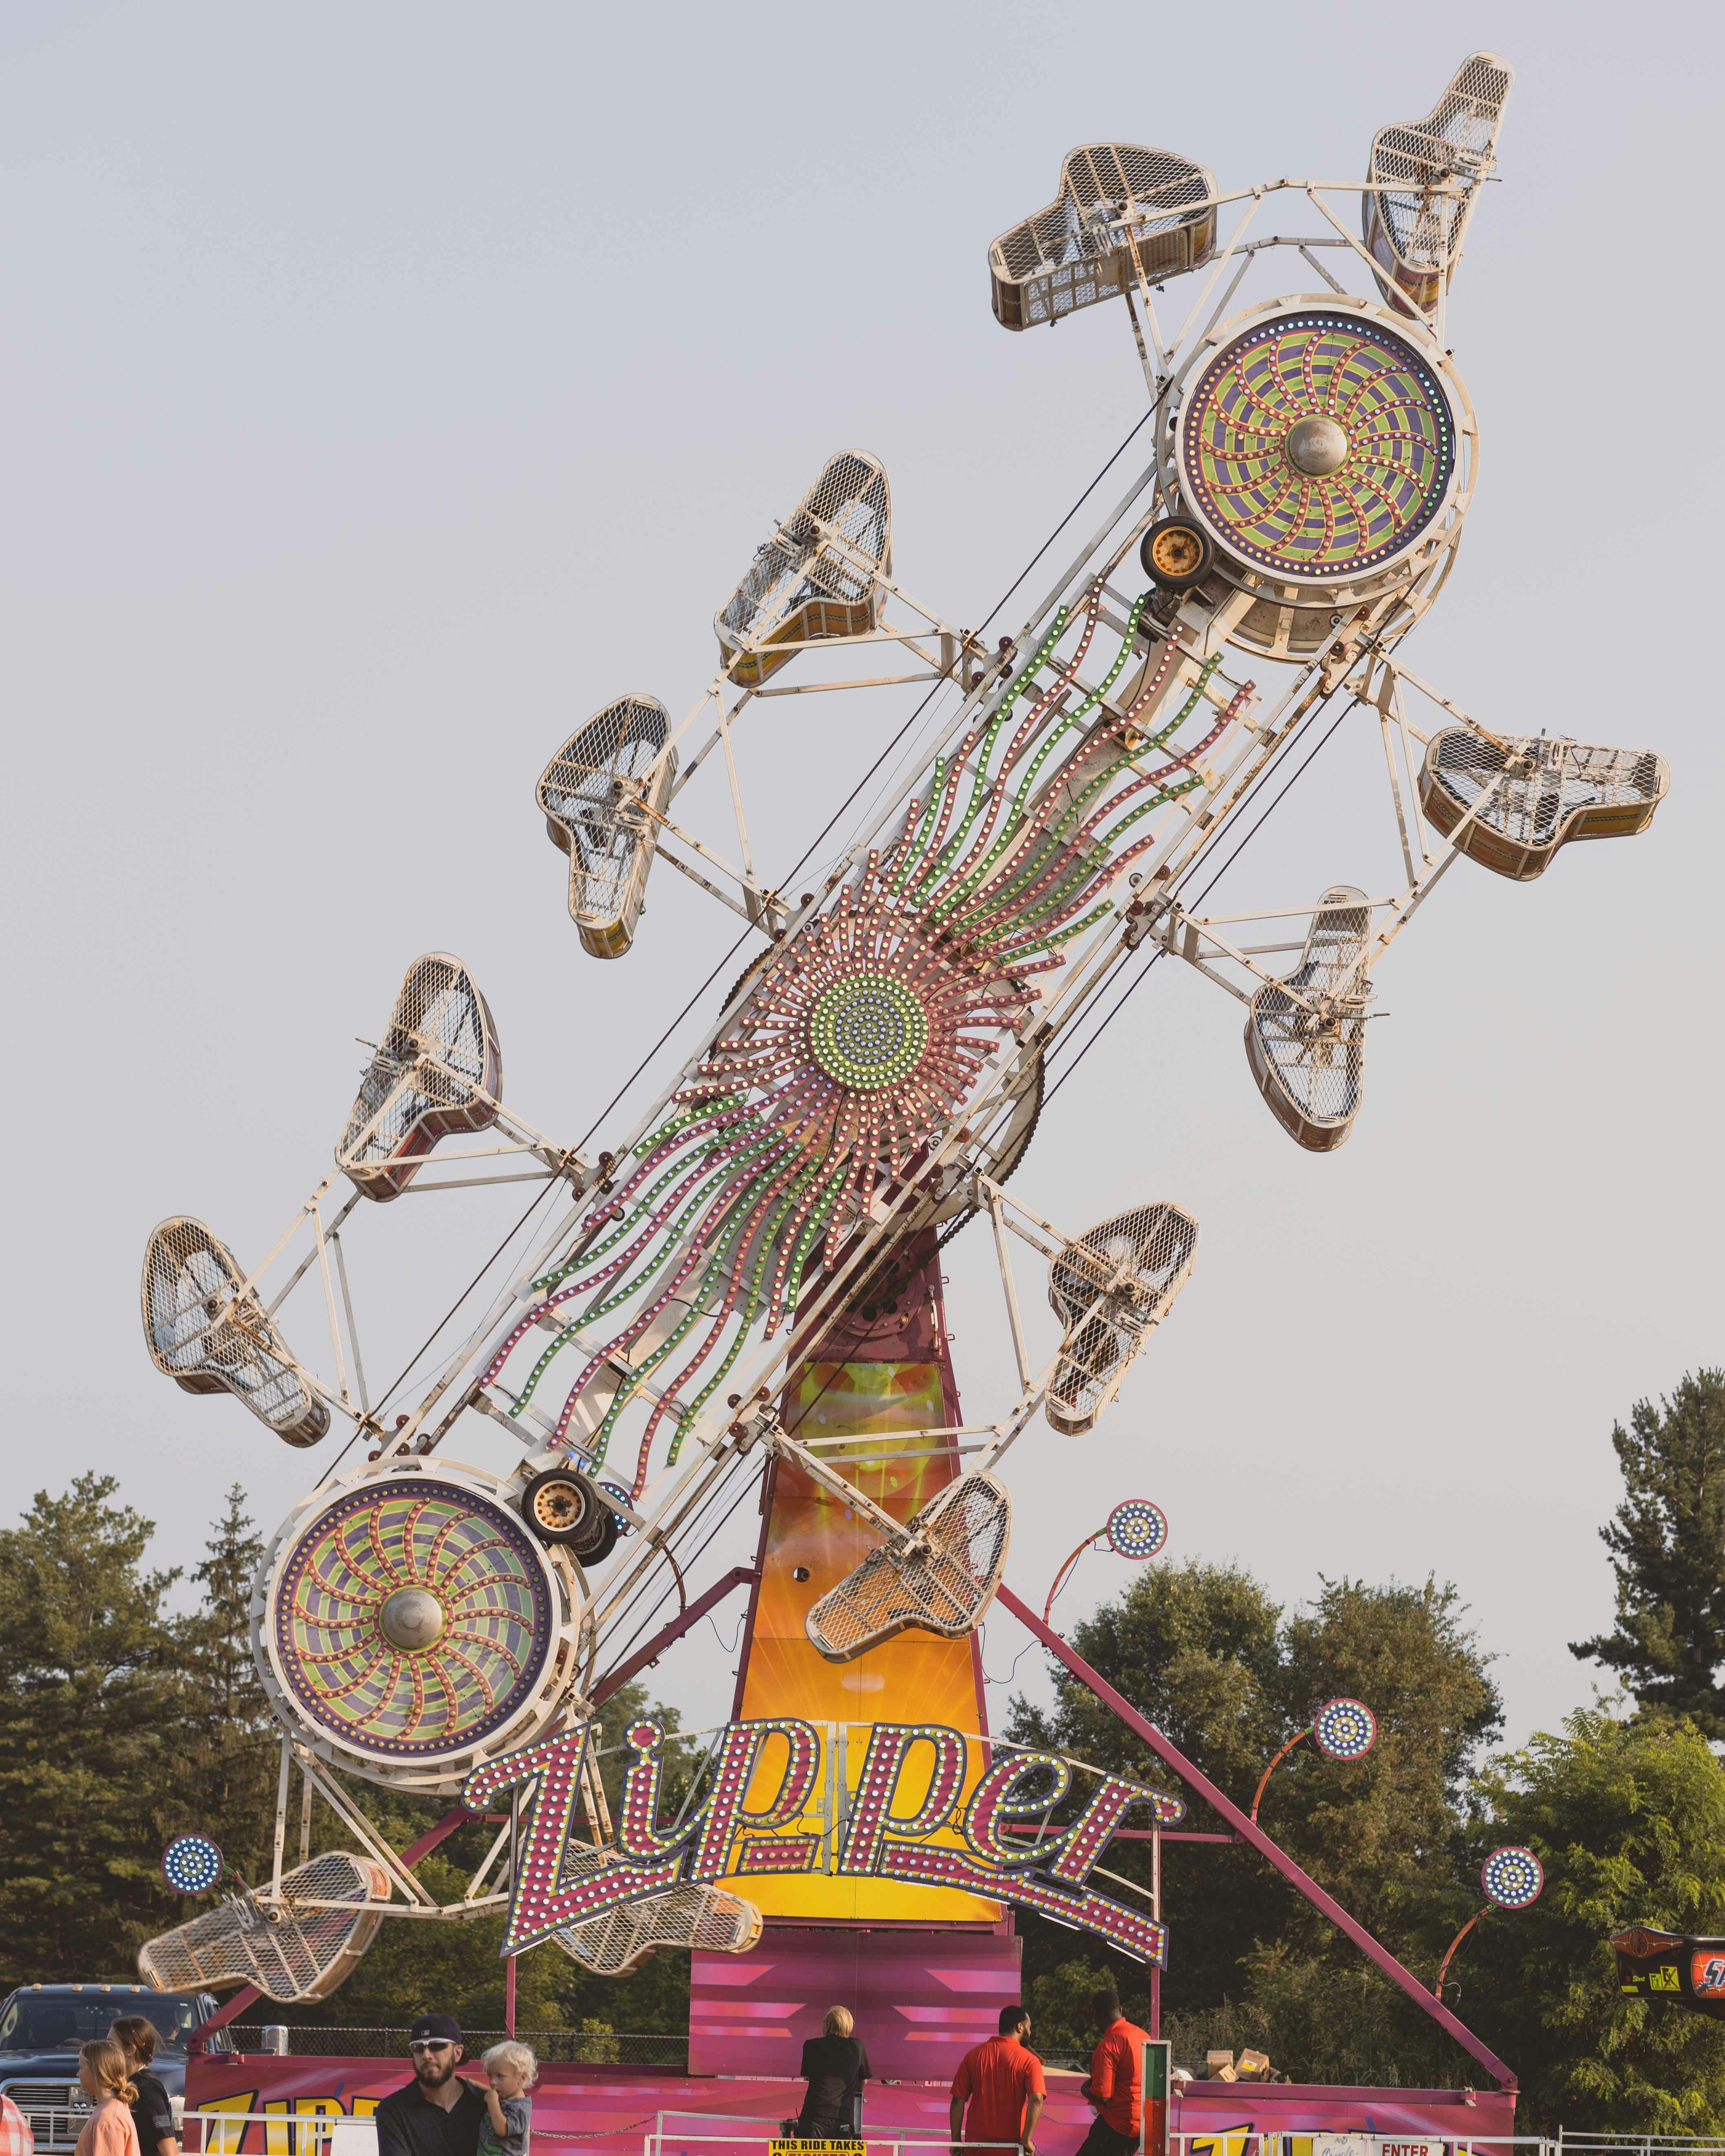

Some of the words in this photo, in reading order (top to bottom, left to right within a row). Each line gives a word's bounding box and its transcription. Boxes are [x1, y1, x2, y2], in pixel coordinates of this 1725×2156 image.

[772, 2140, 797, 2150] THIS
[801, 2141, 827, 2150] RIDE
[829, 2141, 864, 2150] TAKES
[1382, 2144, 1429, 2156] ENTER
